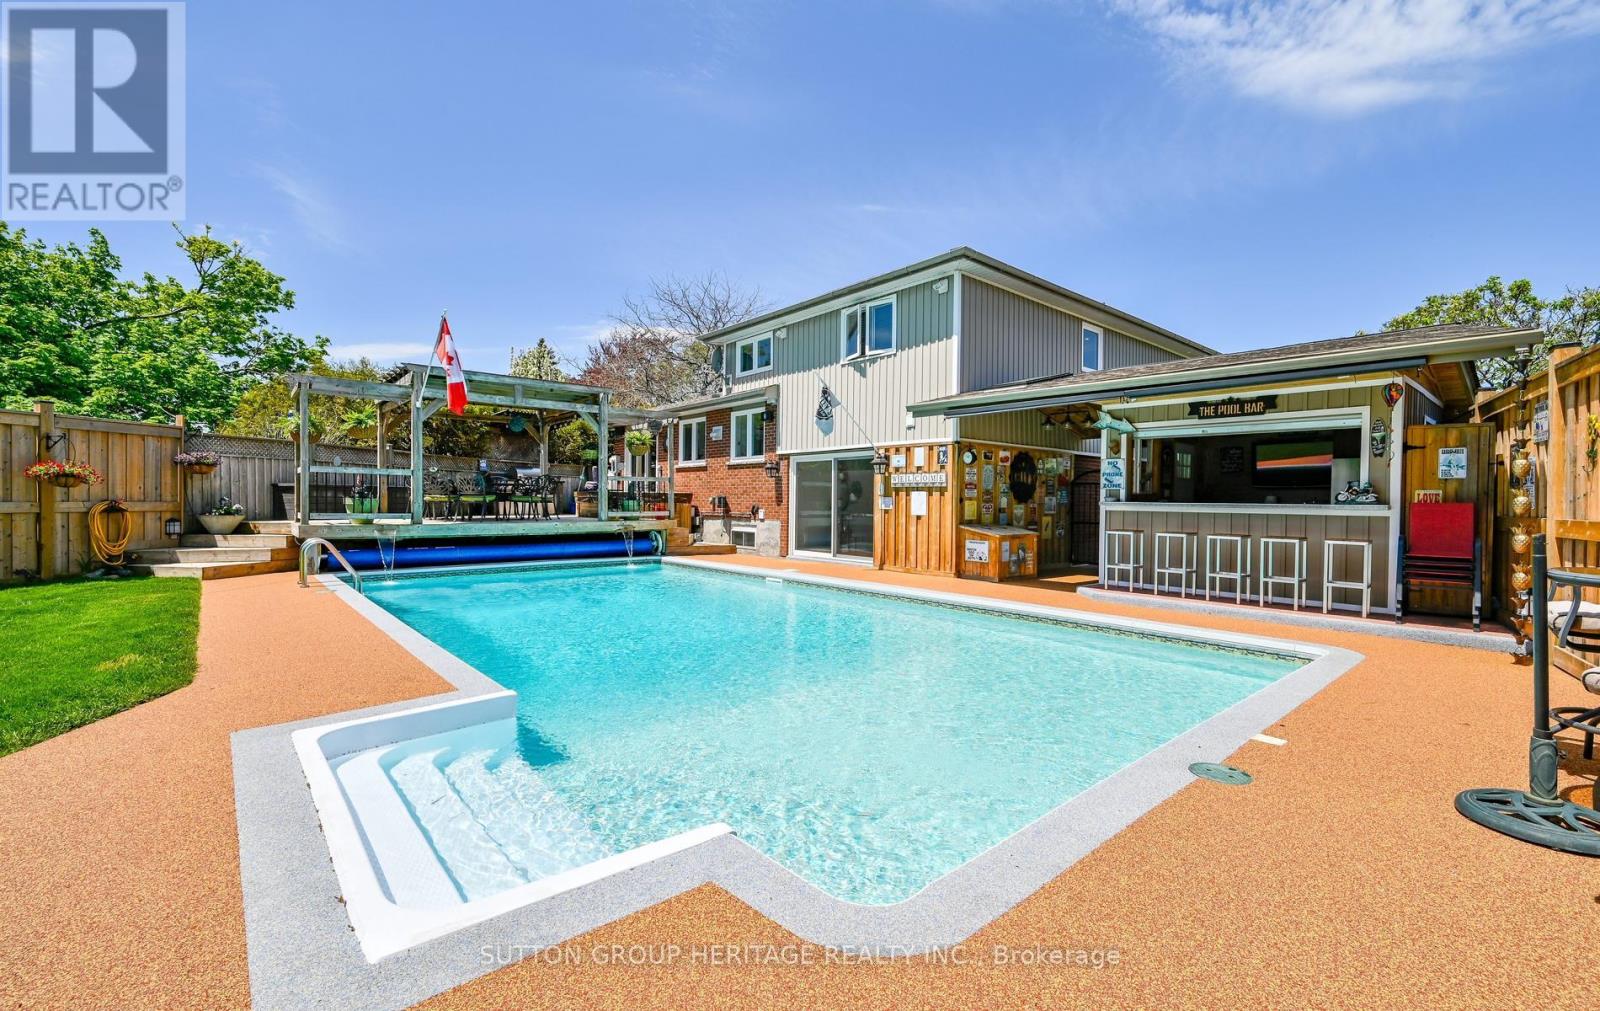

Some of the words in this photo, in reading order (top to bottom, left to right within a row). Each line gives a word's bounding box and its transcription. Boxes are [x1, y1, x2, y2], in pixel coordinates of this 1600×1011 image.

[1199, 405, 1216, 417] THE
[1217, 403, 1242, 415] POOL
[1244, 401, 1265, 414] BAR
[891, 473, 945, 484] WELCOME
[1416, 492, 1441, 504] LOVE
